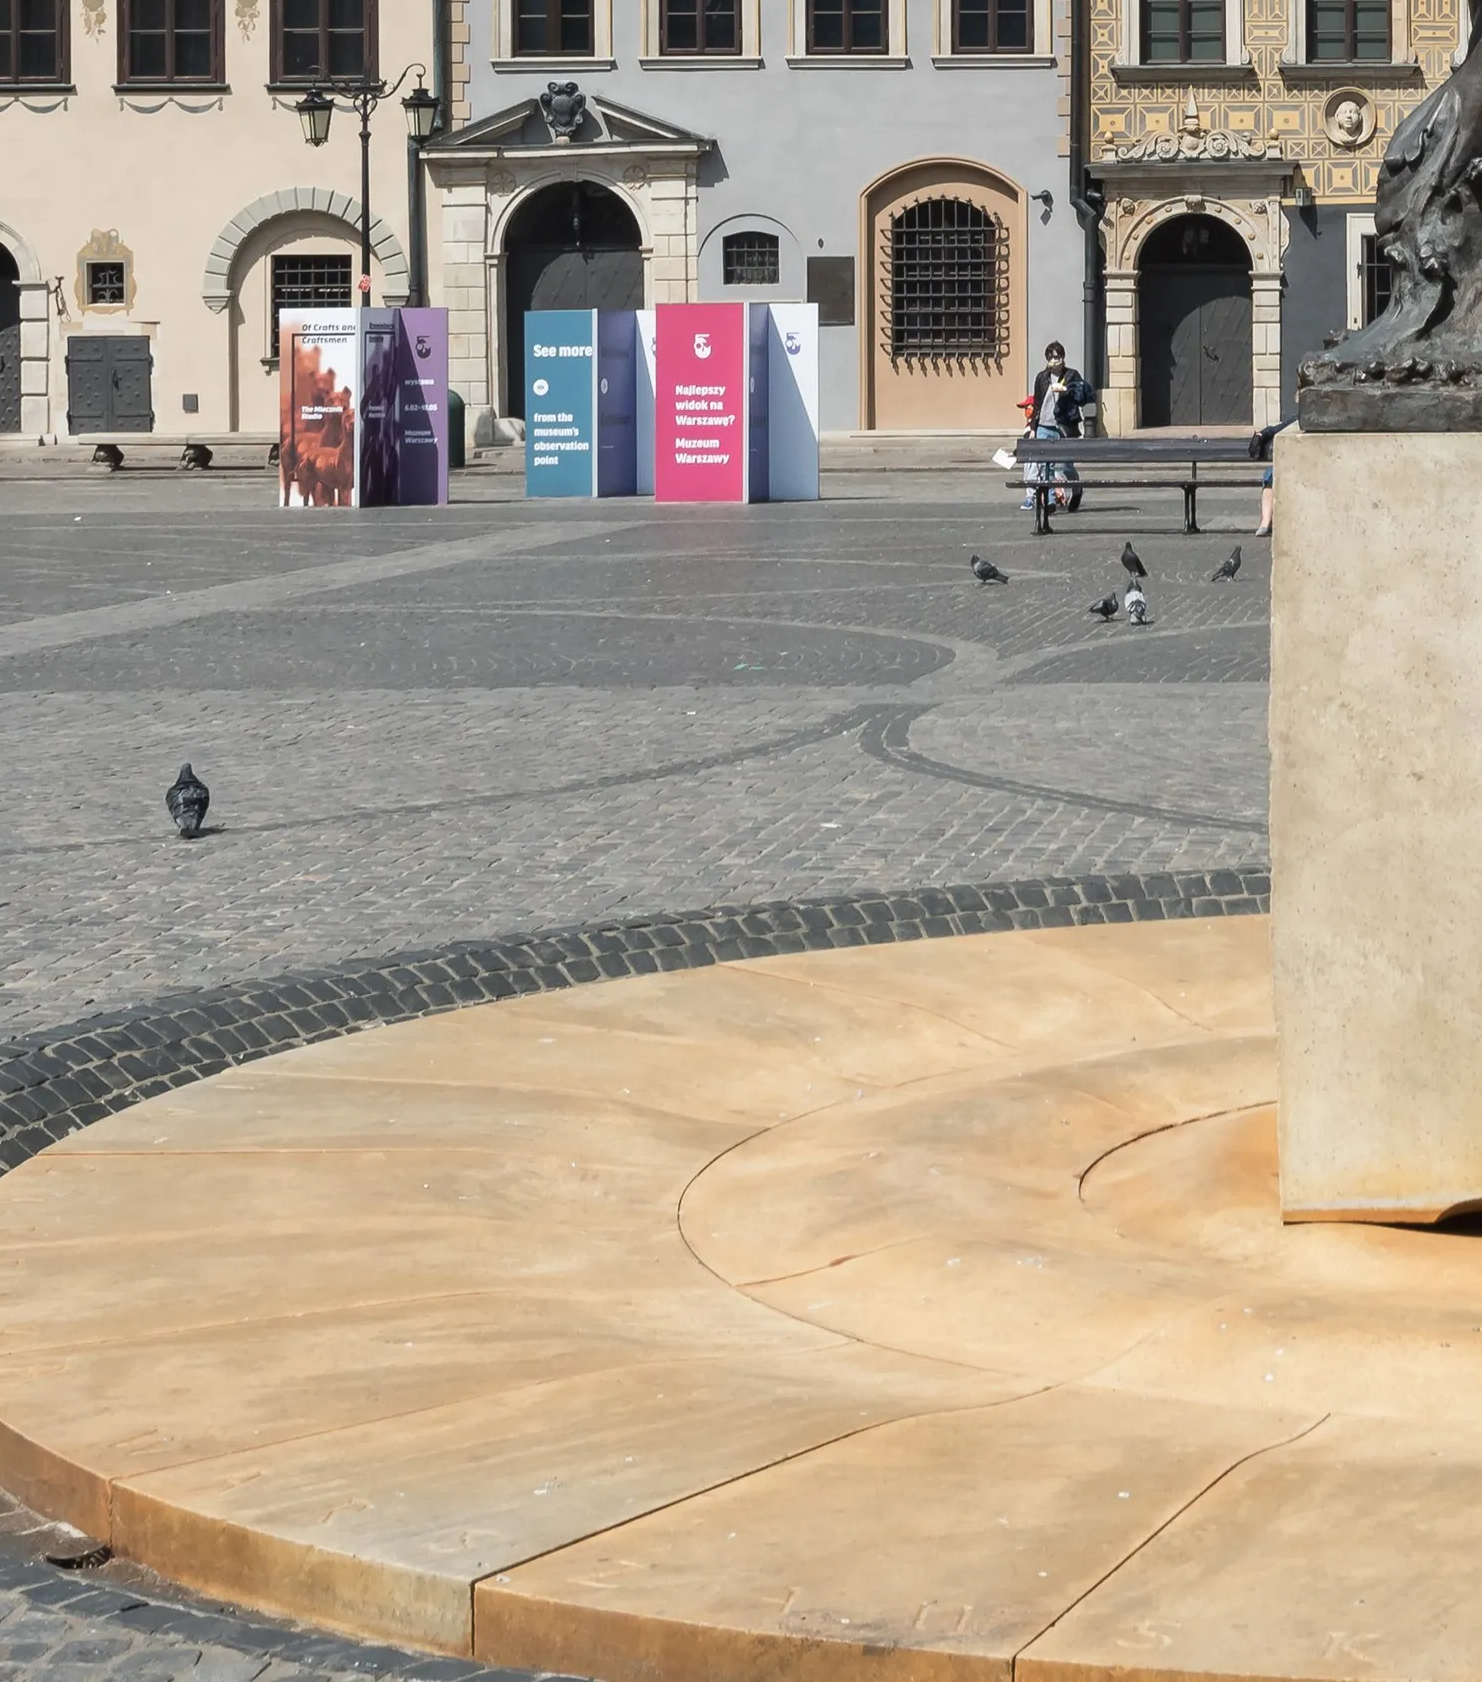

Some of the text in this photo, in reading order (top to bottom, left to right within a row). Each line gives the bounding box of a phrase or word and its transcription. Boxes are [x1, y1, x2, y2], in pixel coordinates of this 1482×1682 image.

[533, 344, 556, 357] See
[559, 346, 593, 357] more
[675, 385, 726, 396] Najlepszy
[675, 400, 723, 410] widok na
[533, 413, 573, 422] from the
[675, 415, 735, 426] Warszawę?
[533, 441, 589, 451] observation
[675, 438, 720, 448] Muzeum
[533, 456, 559, 466] point
[675, 454, 730, 464] Warszawy
